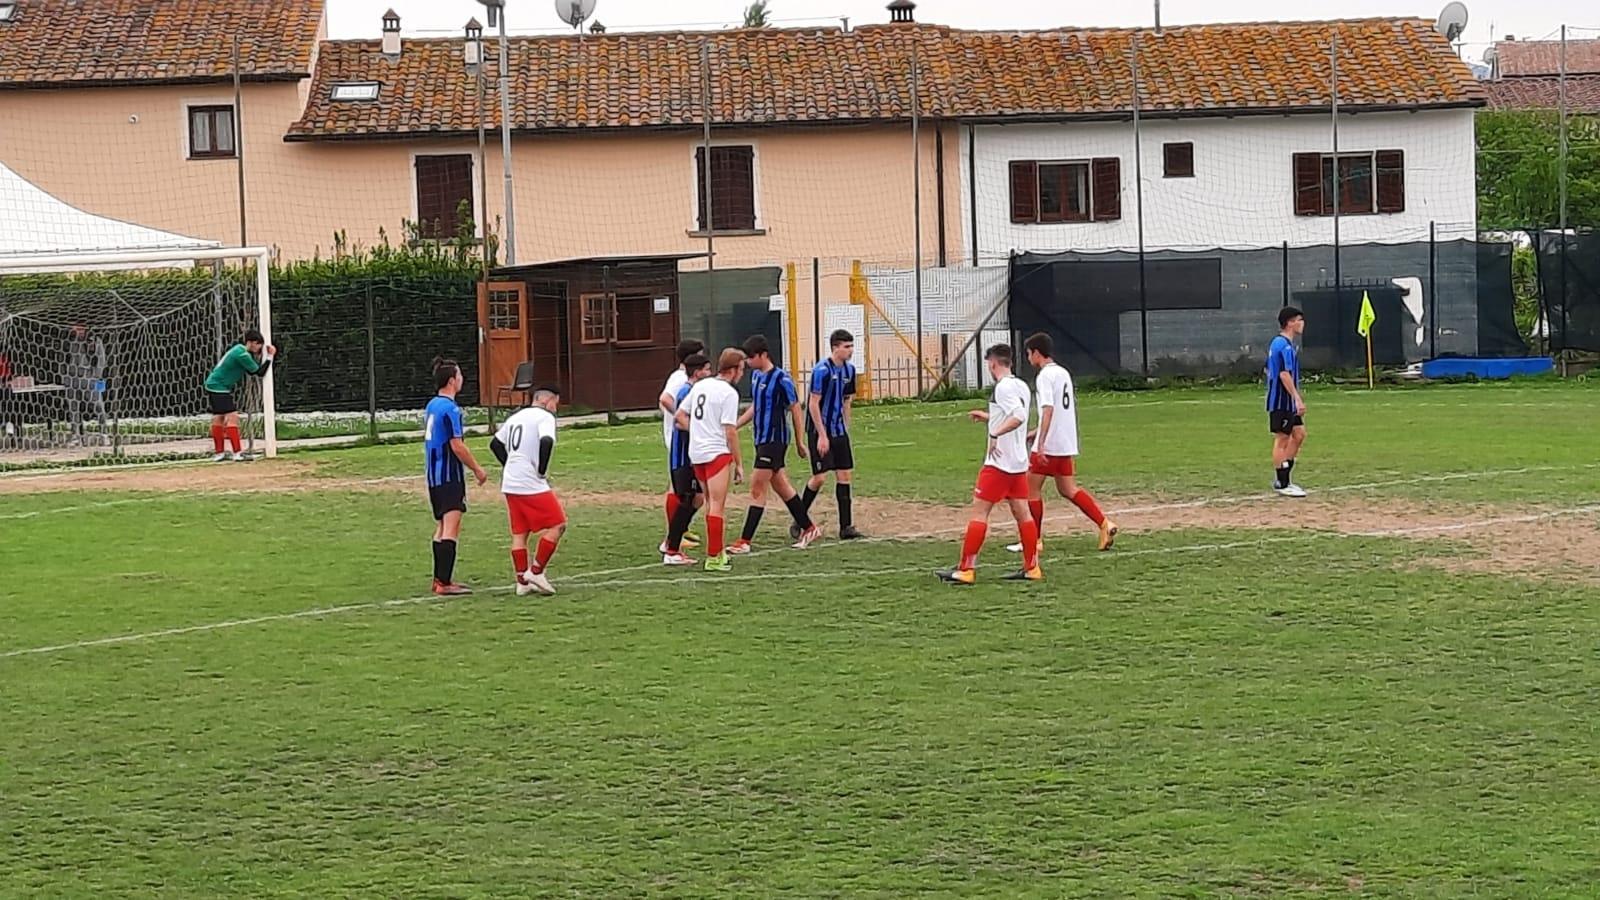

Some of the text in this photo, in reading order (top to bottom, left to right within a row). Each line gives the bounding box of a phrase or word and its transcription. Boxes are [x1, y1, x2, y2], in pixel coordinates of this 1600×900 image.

[694, 393, 706, 420] 8
[1062, 382, 1070, 410] 6
[508, 424, 523, 452] 10
